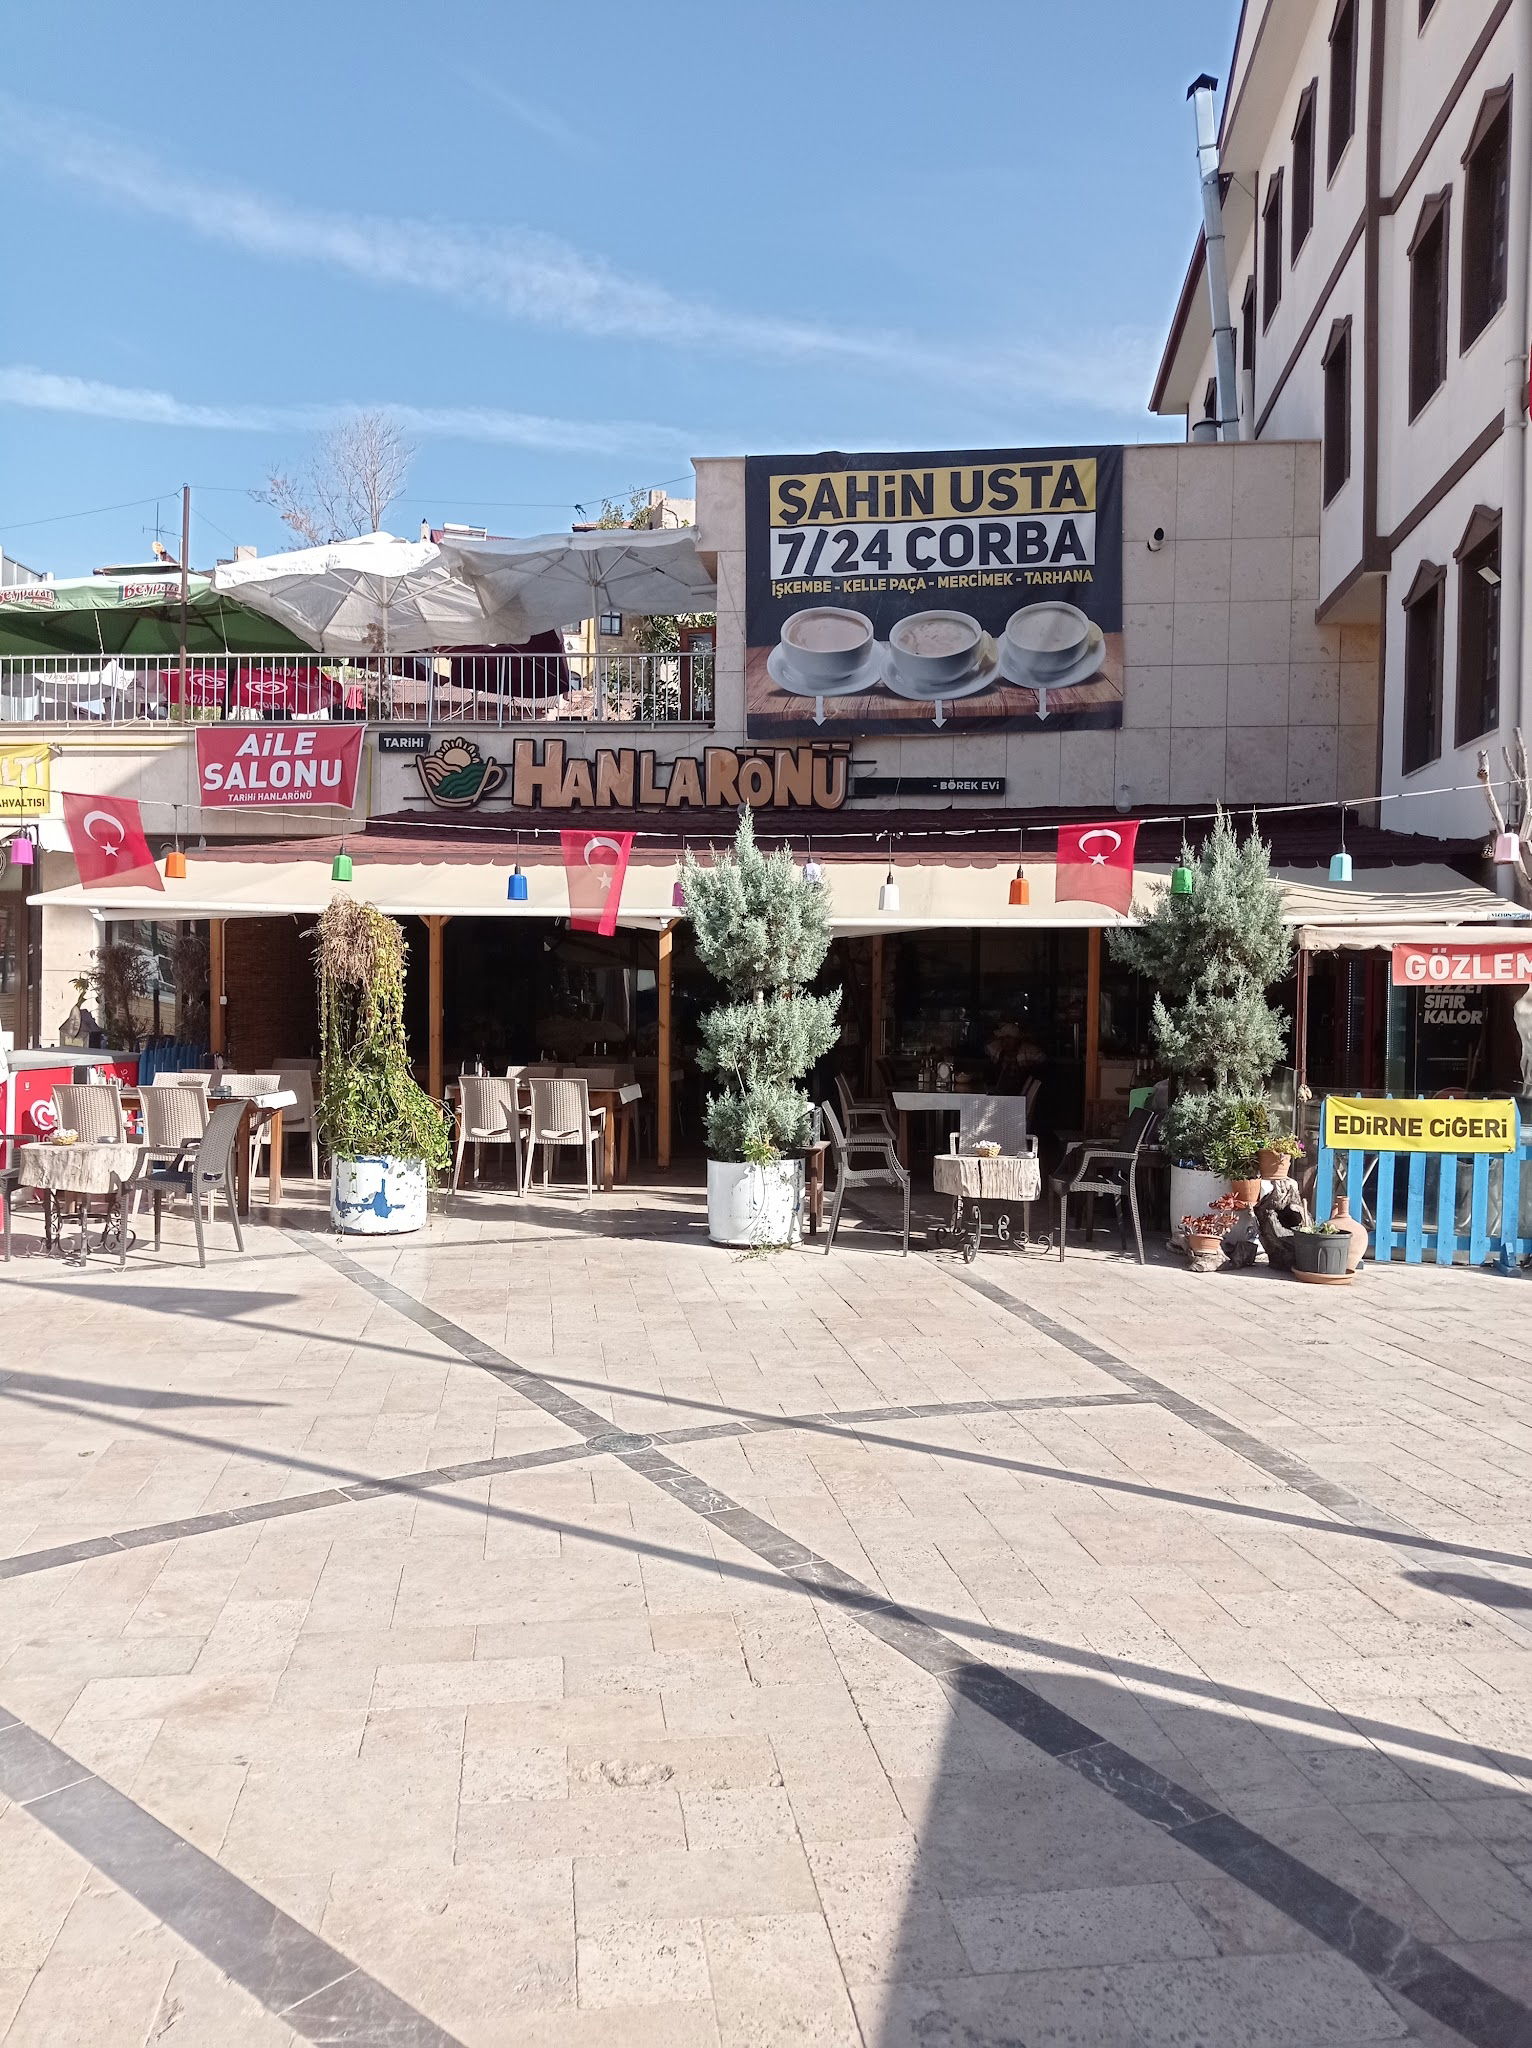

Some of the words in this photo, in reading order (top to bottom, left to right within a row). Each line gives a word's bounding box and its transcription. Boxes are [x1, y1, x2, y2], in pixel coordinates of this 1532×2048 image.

[950, 465, 1087, 512] USTA
[778, 528, 893, 576] 7/24
[905, 519, 1087, 571] ÇORBA
[843, 578, 887, 593] KELLE
[889, 577, 926, 594] PAÇA
[937, 571, 1014, 589] MERCİMEK
[1024, 569, 1093, 585] TARHANA
[124, 584, 187, 599] Beypaza
[203, 760, 342, 791] SALONU
[513, 738, 850, 811] HANLARÖNÜ
[940, 780, 978, 790] BÖREK
[257, 790, 312, 801] HANLARÖNÜ
[0, 798, 45, 809] HVALTISI
[1424, 995, 1466, 1009] SIFIR
[1424, 1010, 1483, 1024] KALOR
